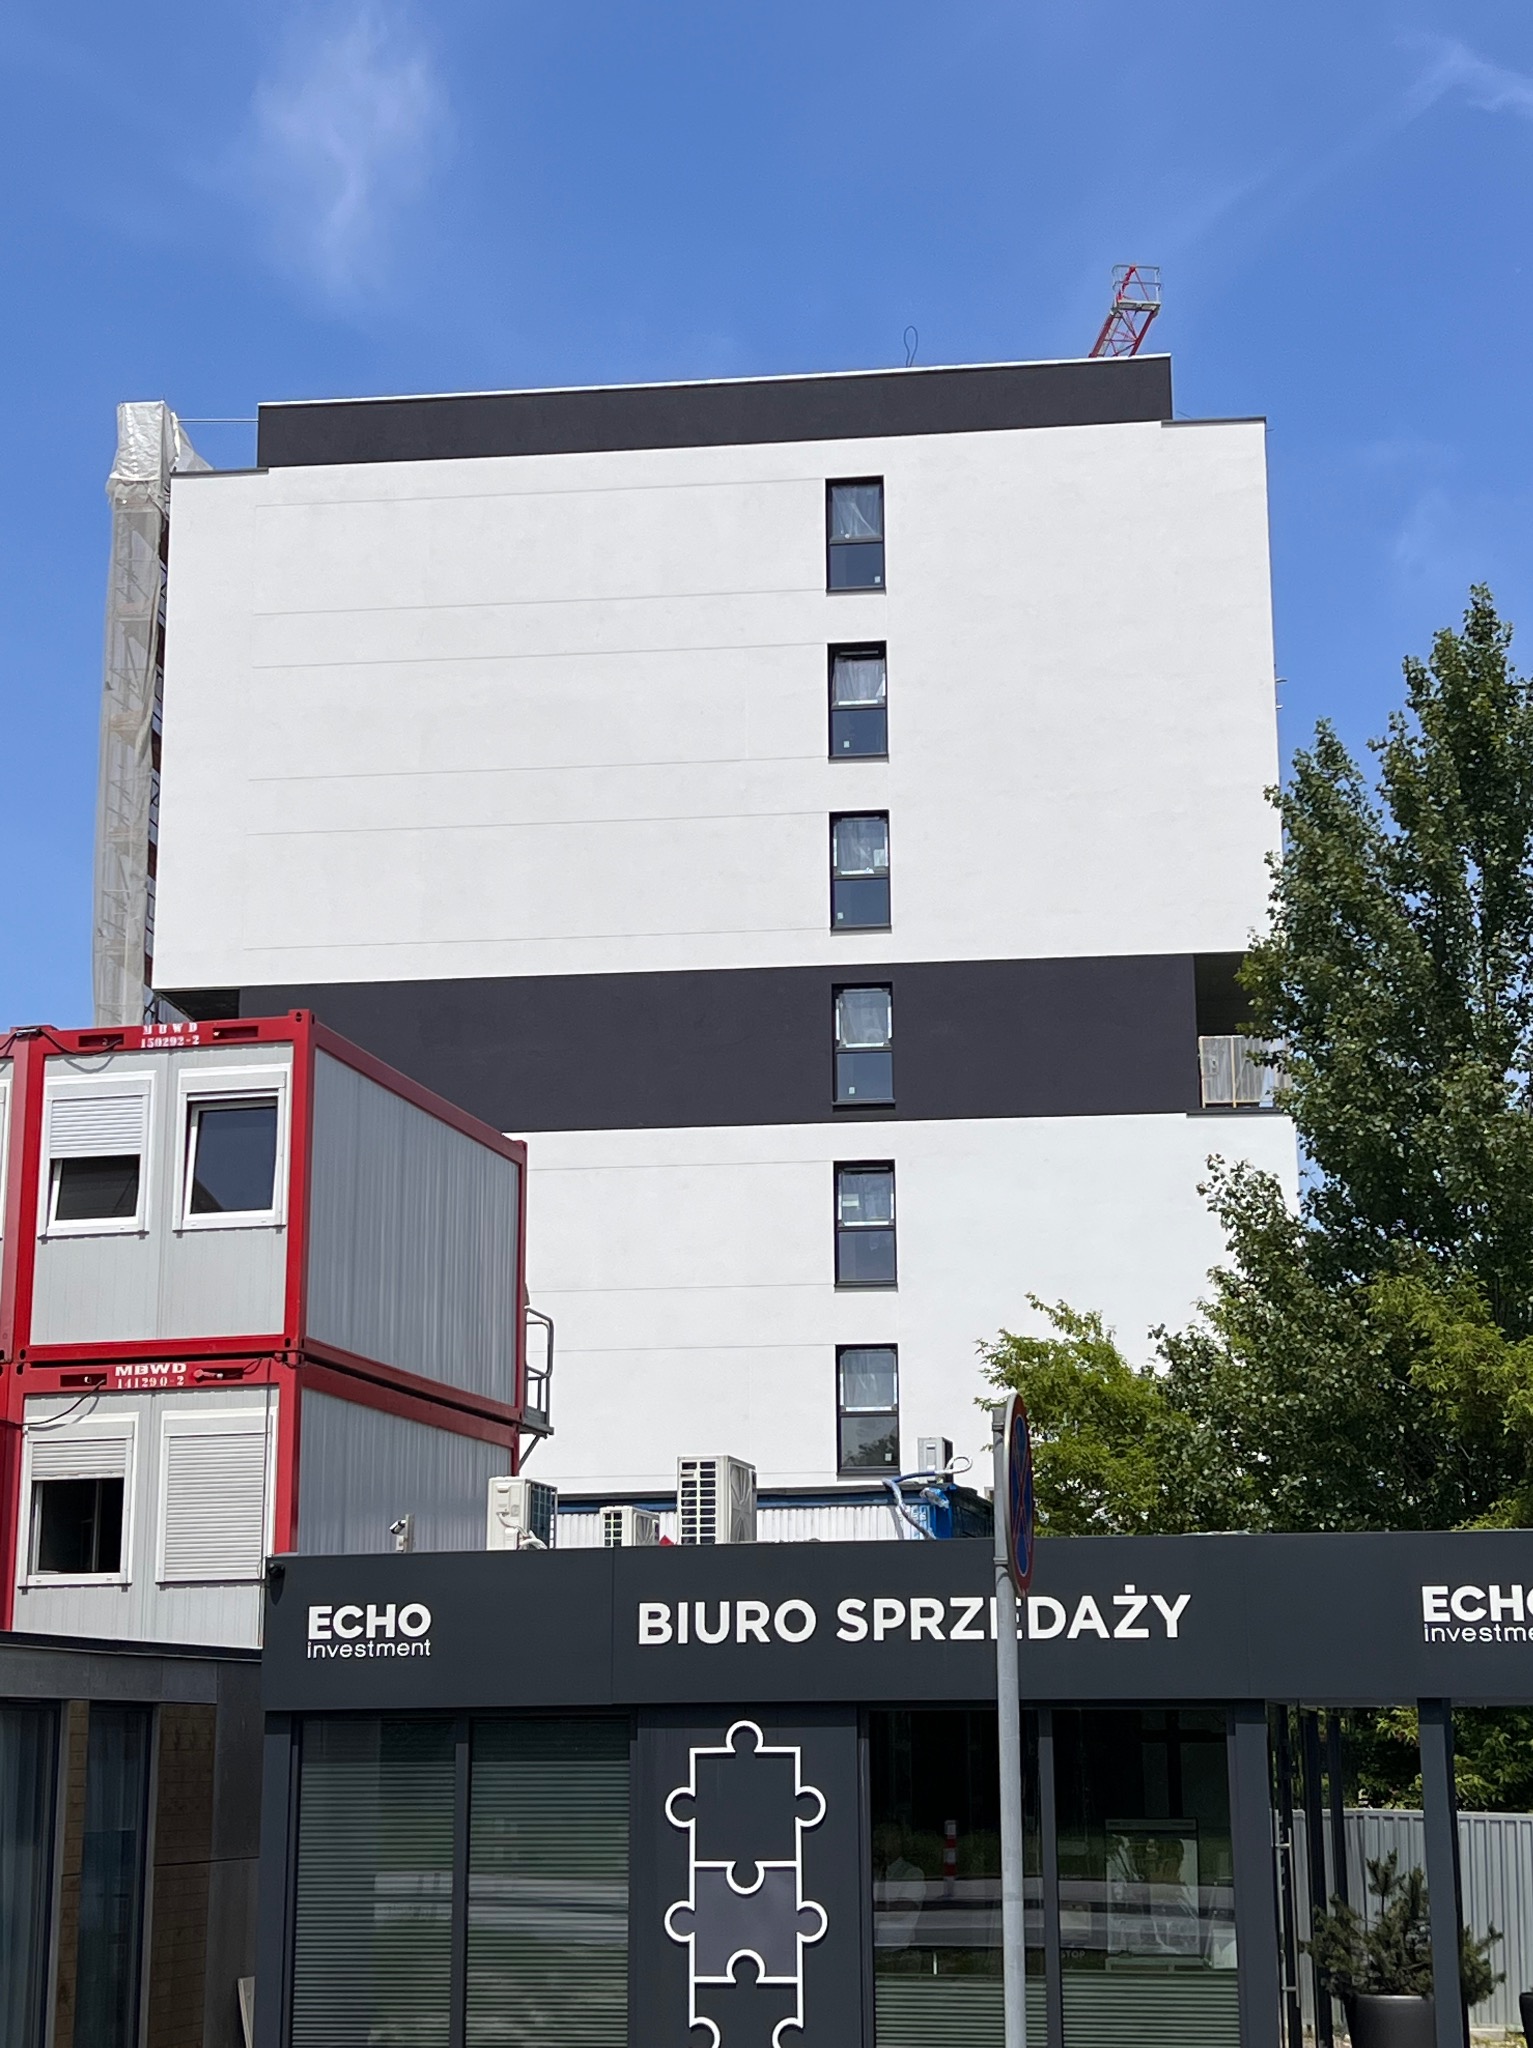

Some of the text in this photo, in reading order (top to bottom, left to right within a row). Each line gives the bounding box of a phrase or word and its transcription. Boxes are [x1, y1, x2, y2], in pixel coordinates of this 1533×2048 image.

[115, 1363, 187, 1377] MBWD
[307, 1603, 432, 1639] ECHO
[1421, 1584, 1533, 1622] ECH
[638, 1600, 818, 1645] BIURO
[306, 1637, 431, 1659] investment
